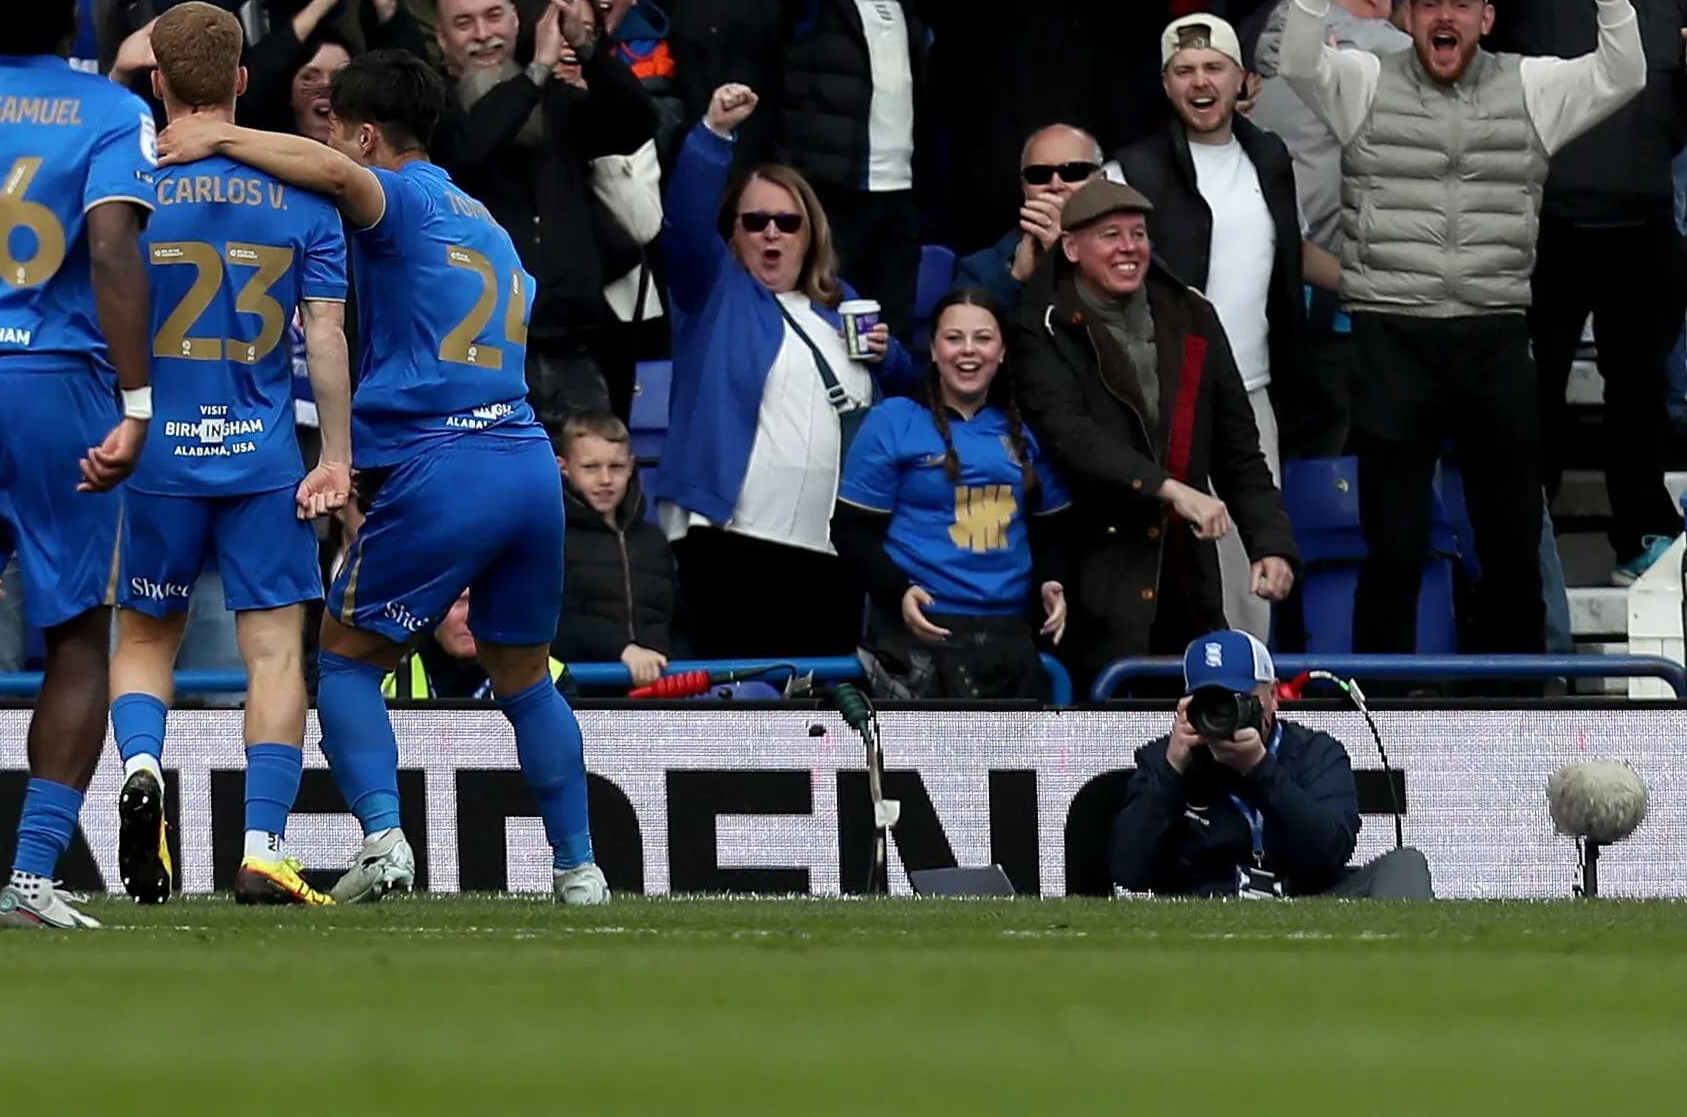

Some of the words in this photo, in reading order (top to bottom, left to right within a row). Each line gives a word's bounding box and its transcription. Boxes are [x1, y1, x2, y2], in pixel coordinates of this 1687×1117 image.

[157, 176, 262, 206] CARLOS
[149, 241, 296, 364] 23
[200, 405, 228, 415] VISIT
[165, 418, 263, 443] BIRMINGHAM
[174, 445, 230, 457] ALABAMA,
[232, 441, 256, 454] USA
